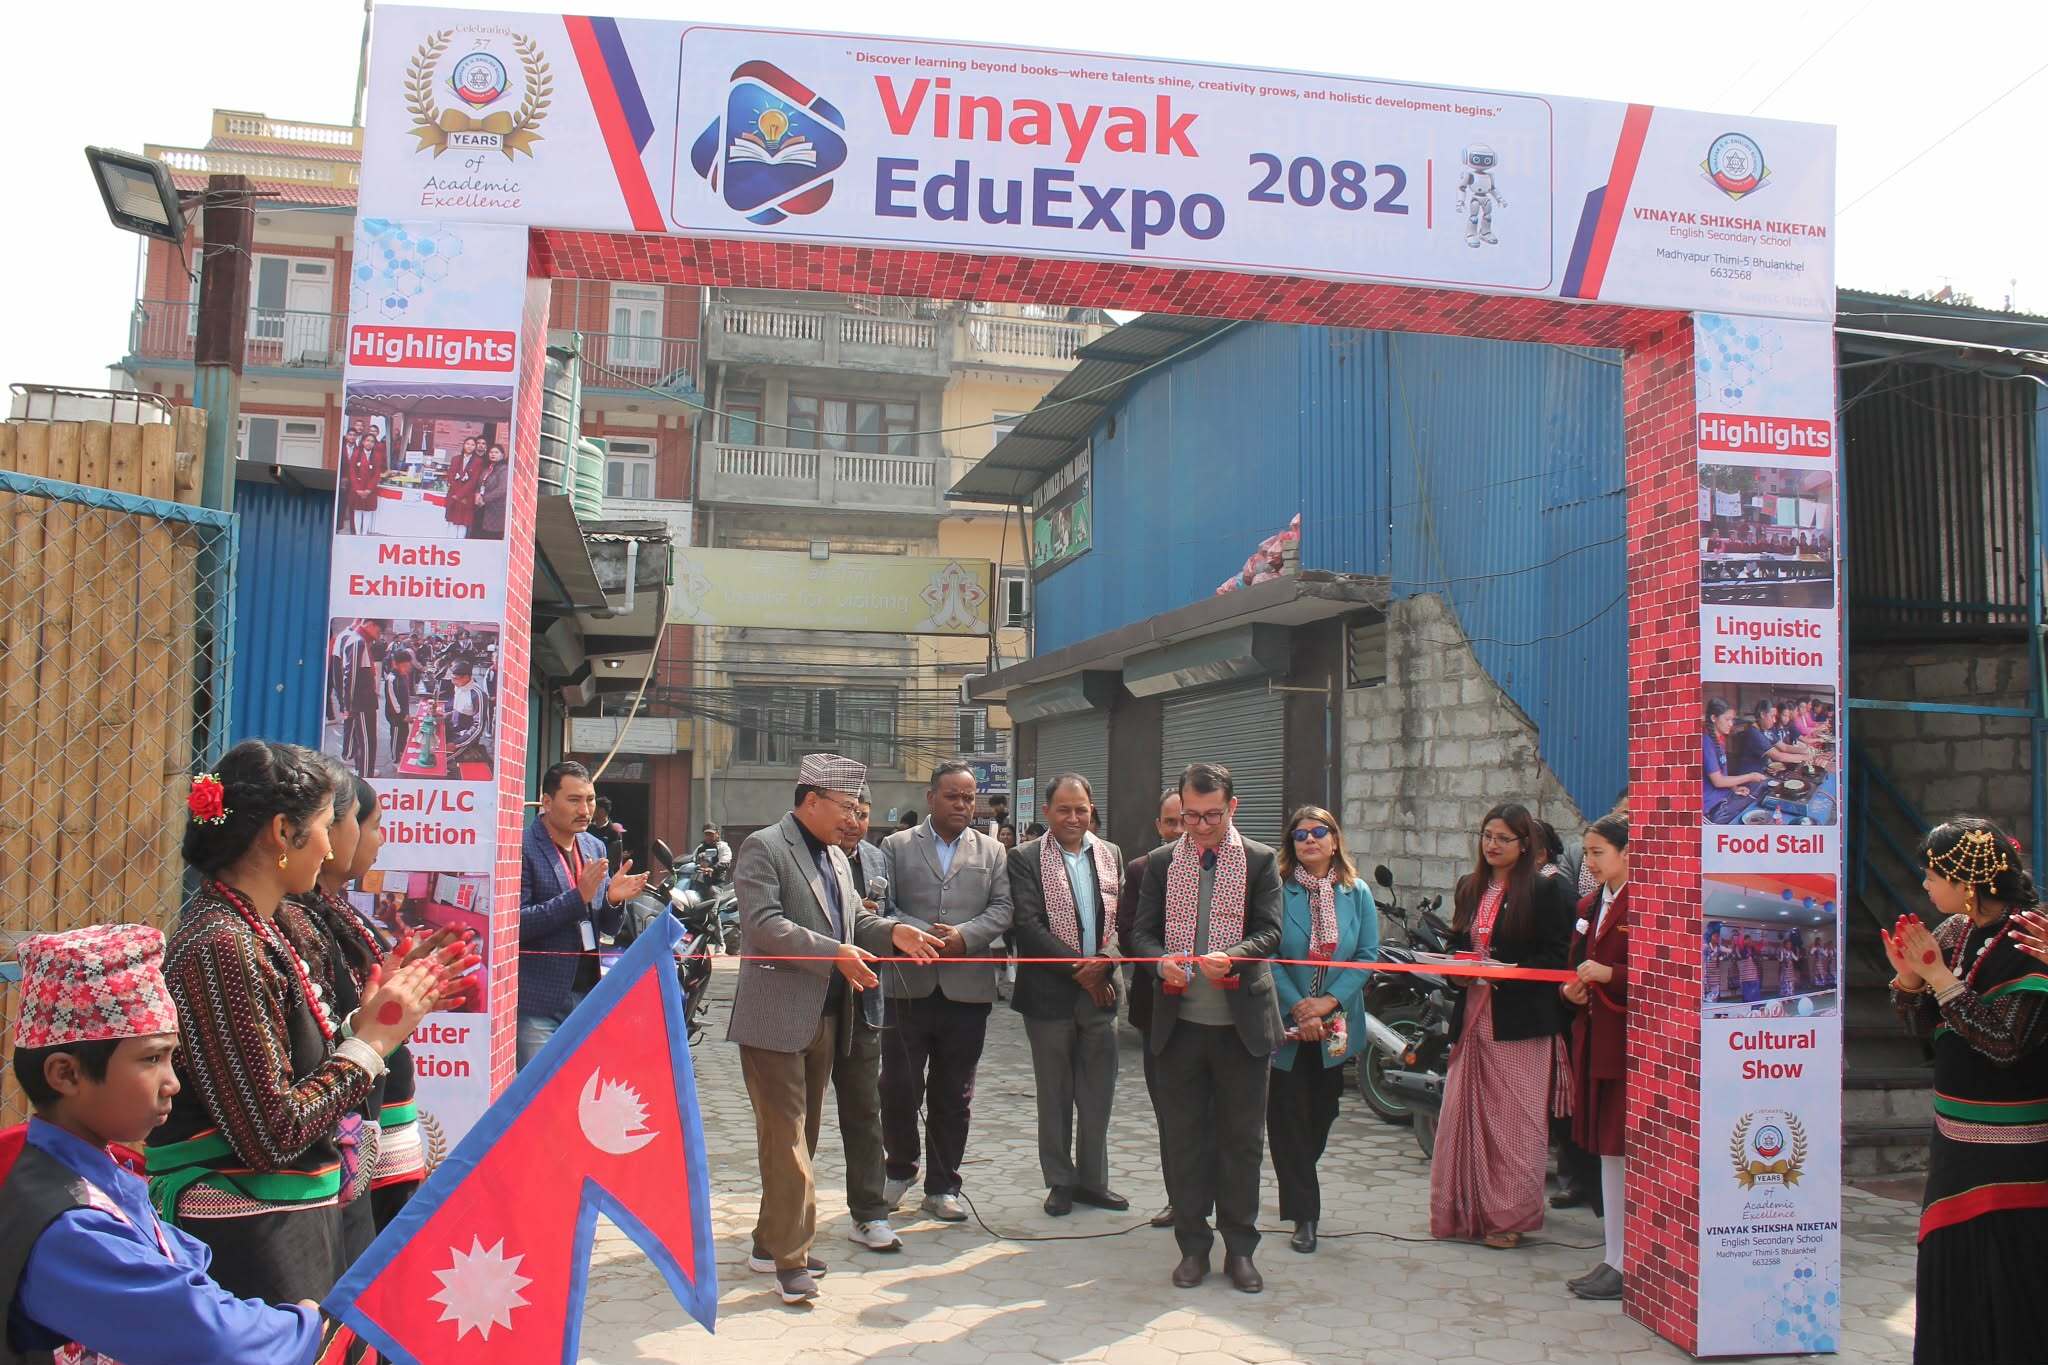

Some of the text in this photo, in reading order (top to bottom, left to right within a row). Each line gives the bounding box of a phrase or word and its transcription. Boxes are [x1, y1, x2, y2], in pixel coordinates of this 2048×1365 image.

[455, 23, 511, 36] Celebrating
[856, 51, 911, 65] Discover
[914, 56, 967, 71] learning
[971, 59, 1017, 74] beyond
[1112, 71, 1155, 84] talents
[1158, 76, 1195, 89] shine,
[1198, 79, 1256, 96] creativity
[1259, 87, 1300, 99] grows,
[1303, 89, 1325, 100] and
[1329, 92, 1372, 105] holistic
[1375, 96, 1451, 113] development
[874, 75, 1199, 164] Vinayak
[453, 134, 498, 146] YEARS
[465, 155, 485, 173] of
[423, 176, 520, 192] Academic
[1247, 152, 1409, 216] 2082
[420, 192, 522, 209] Excellence
[875, 157, 1226, 250] EduExpo
[1633, 207, 1826, 238] VINAYAK SHIKSHA NIKETAN
[1670, 226, 1792, 247] English Secondary School
[1656, 248, 1709, 263] Madhyapur
[1712, 253, 1750, 267] Thimi-5
[1710, 267, 1752, 280] 6632568
[352, 331, 513, 366] Highlights
[1700, 418, 1830, 452] Highlights
[378, 543, 461, 567] Maths
[349, 575, 486, 601] Exhibition
[1716, 616, 1822, 642] Linguistic
[1714, 645, 1824, 668] Exhibition
[1717, 833, 1825, 855] Food Stall
[1728, 1029, 1816, 1051] Cultural
[1742, 1059, 1803, 1080] Show
[1757, 1174, 1781, 1182] YEARS
[1742, 1209, 1796, 1220] Excellence
[1744, 1200, 1795, 1210] Academic
[1706, 1221, 1838, 1236] VINAYAK SHIKSHA NIKETAN
[1721, 1234, 1823, 1248] English Secondary School
[1716, 1249, 1752, 1260] Madhyapur
[1752, 1258, 1782, 1267] 6632568
